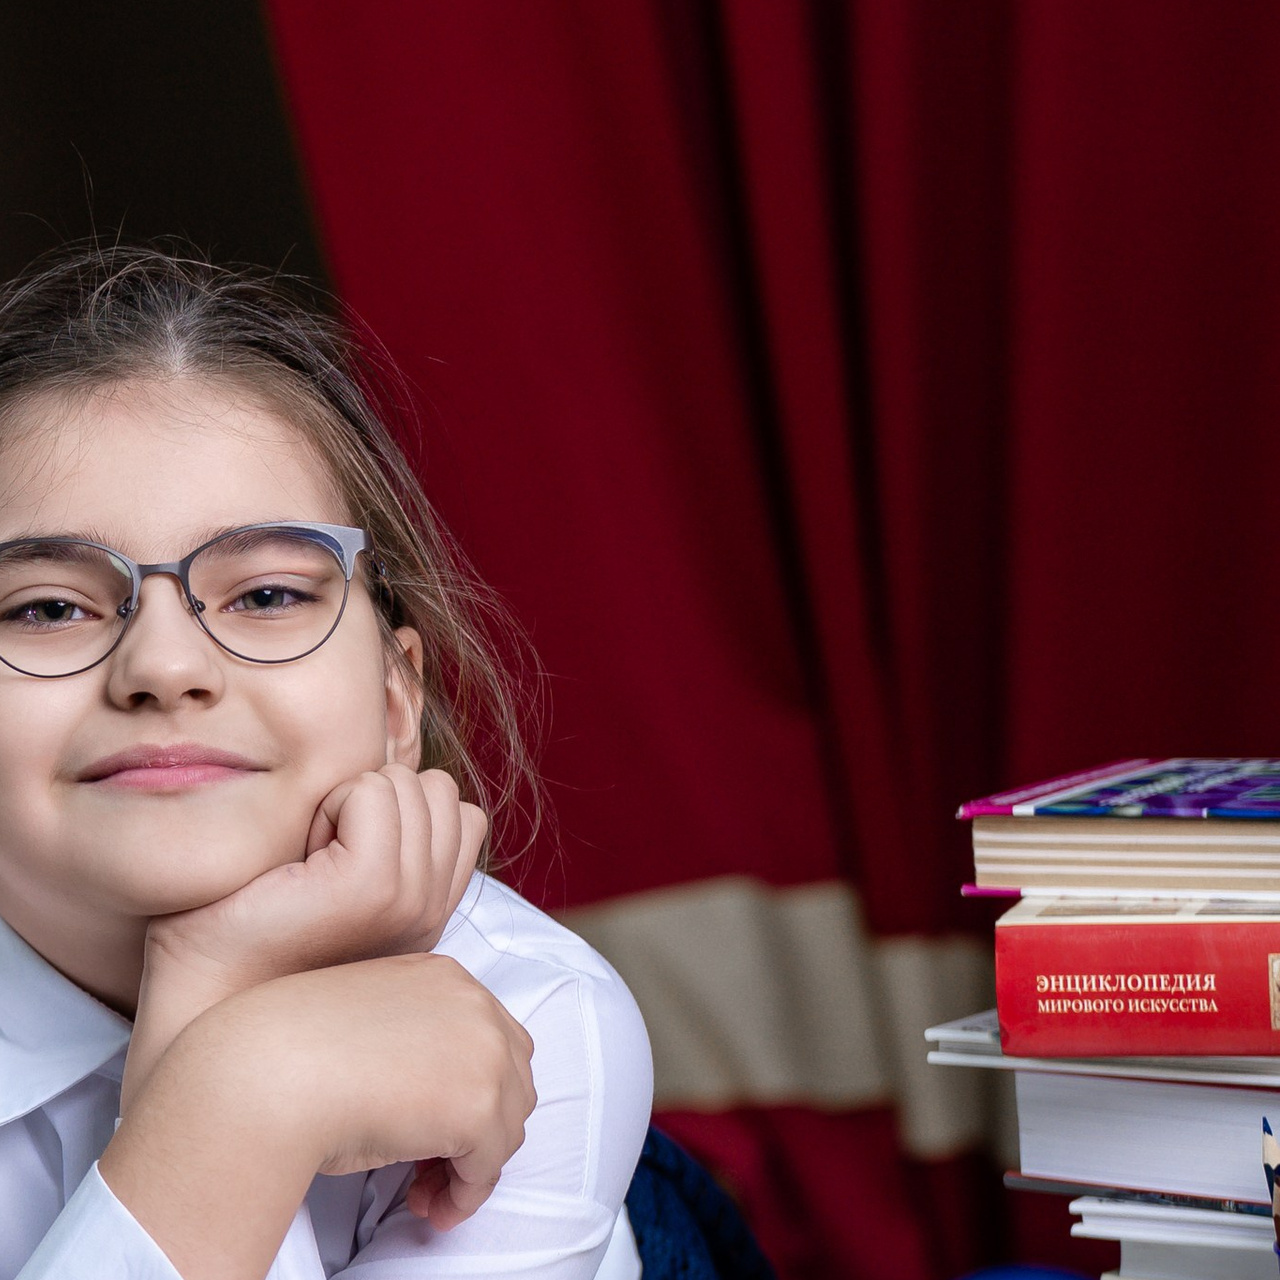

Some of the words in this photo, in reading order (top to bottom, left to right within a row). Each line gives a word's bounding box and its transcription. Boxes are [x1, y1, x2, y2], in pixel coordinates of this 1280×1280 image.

[1036, 974, 1217, 993] ЭНЦИКЛОПЕДИЯ
[1037, 999, 1125, 1013] МИРОВОГО
[1128, 998, 1219, 1013] ИСКУССТВА
